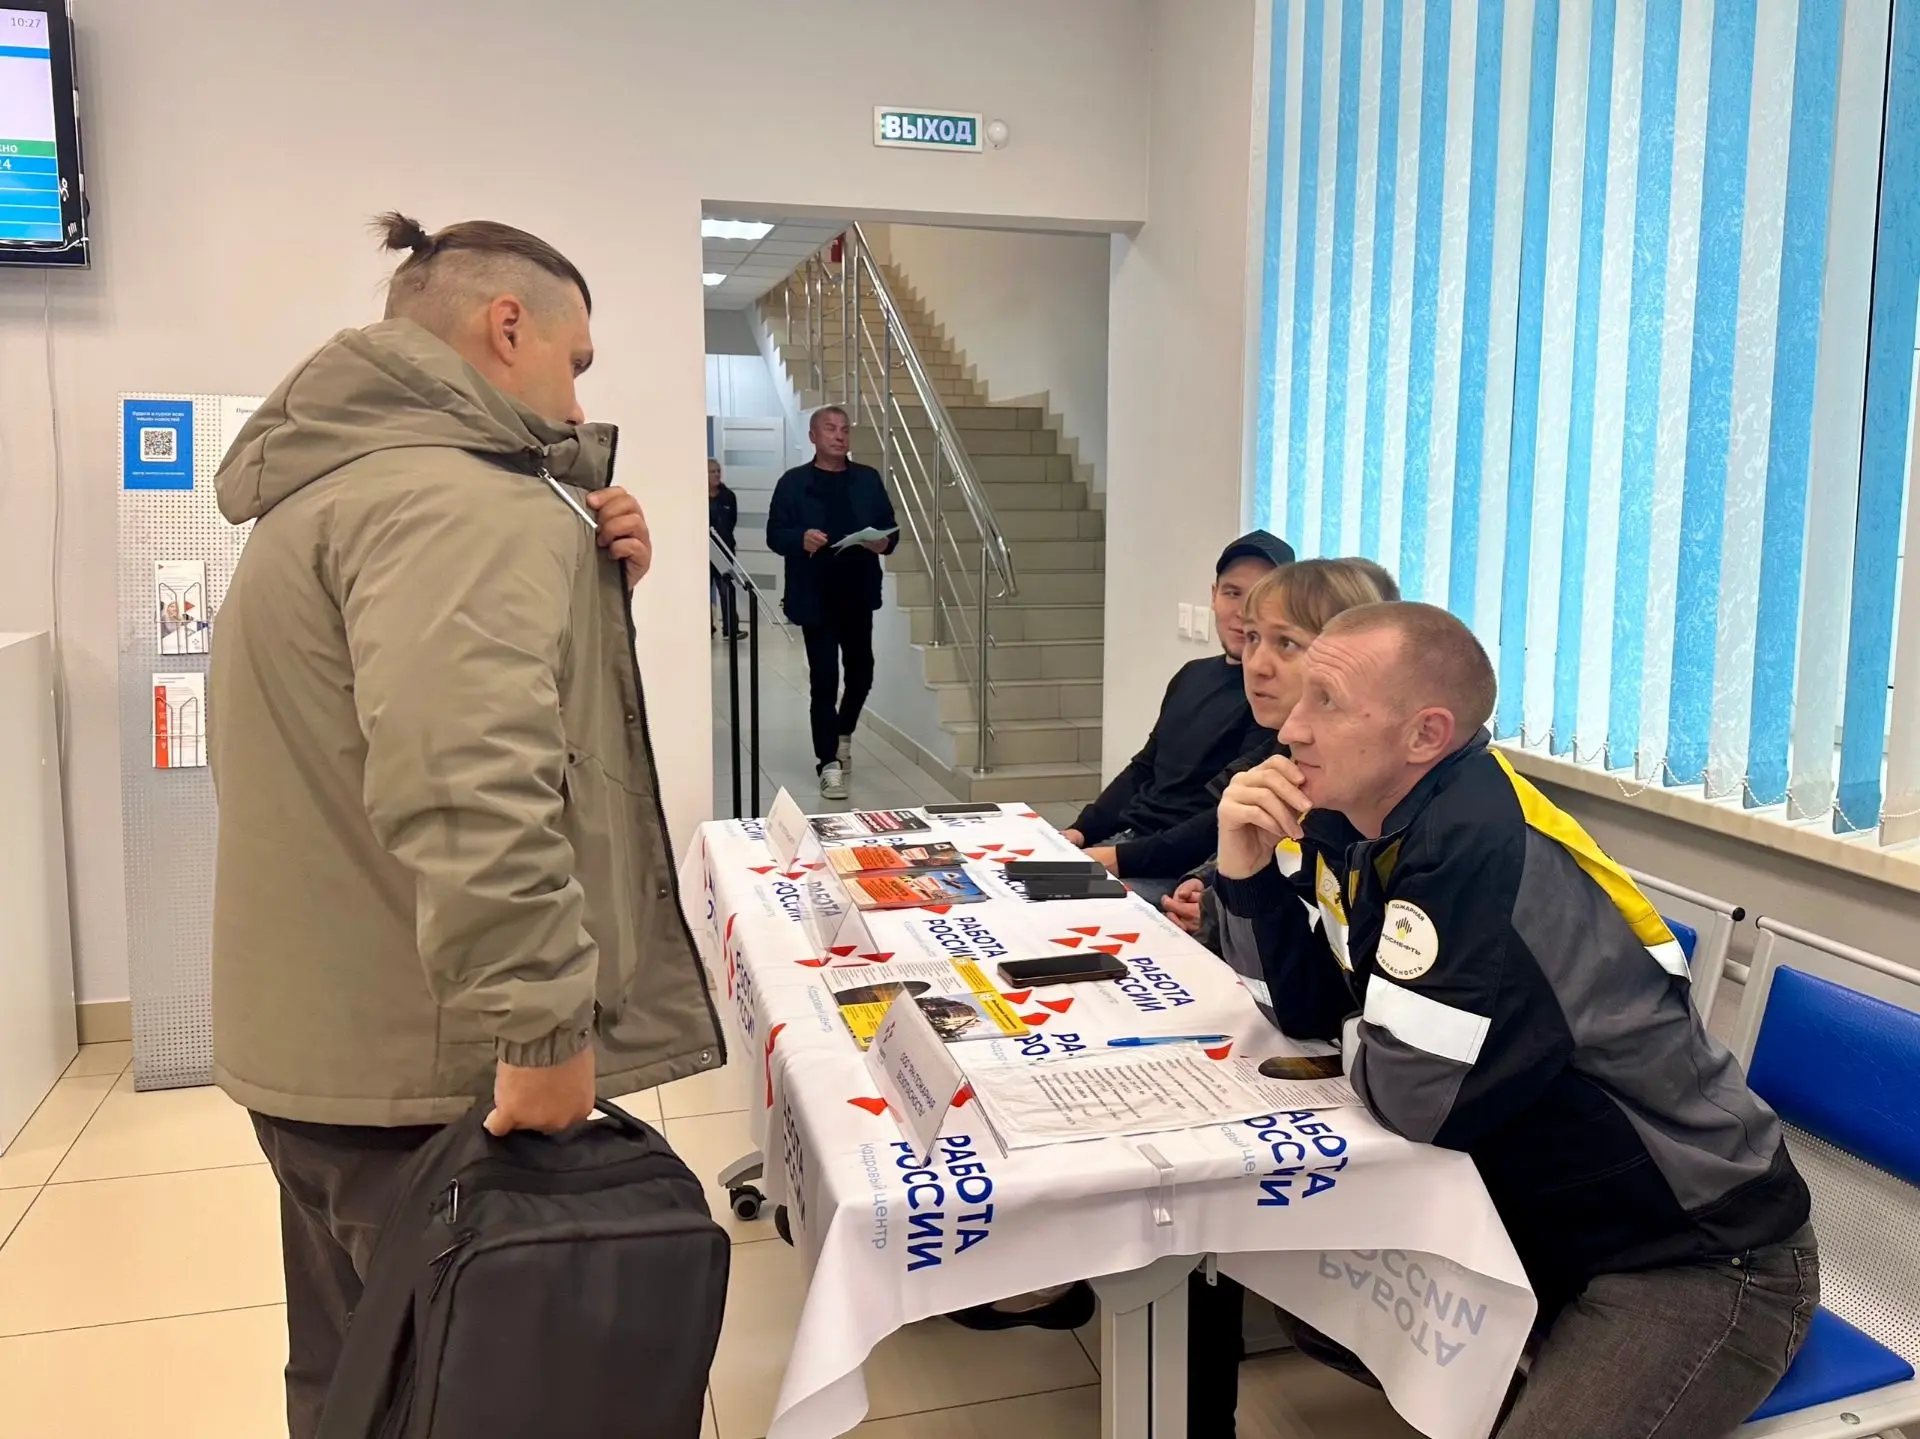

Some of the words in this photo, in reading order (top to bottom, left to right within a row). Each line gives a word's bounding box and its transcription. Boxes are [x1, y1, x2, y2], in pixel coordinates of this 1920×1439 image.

[11, 17, 42, 29] 10:27
[0, 143, 18, 153] НО
[885, 114, 972, 143] ВЫХОД
[1391, 903, 1426, 922] ПОЖАРНАЯ
[952, 916, 1009, 958] РАБОТА
[1127, 957, 1196, 1007] РАБОТА
[1377, 949, 1424, 976] ЗОПАСНОСТЬ
[1114, 976, 1168, 1012] ССИИ
[860, 1142, 886, 1192] Кадровый
[1243, 1115, 1306, 1206] ОССИИ
[1279, 1111, 1349, 1199] АБОТА
[889, 1141, 945, 1272] РОССИИ
[935, 1134, 994, 1255] РАБОТА
[872, 1192, 888, 1250] центр
